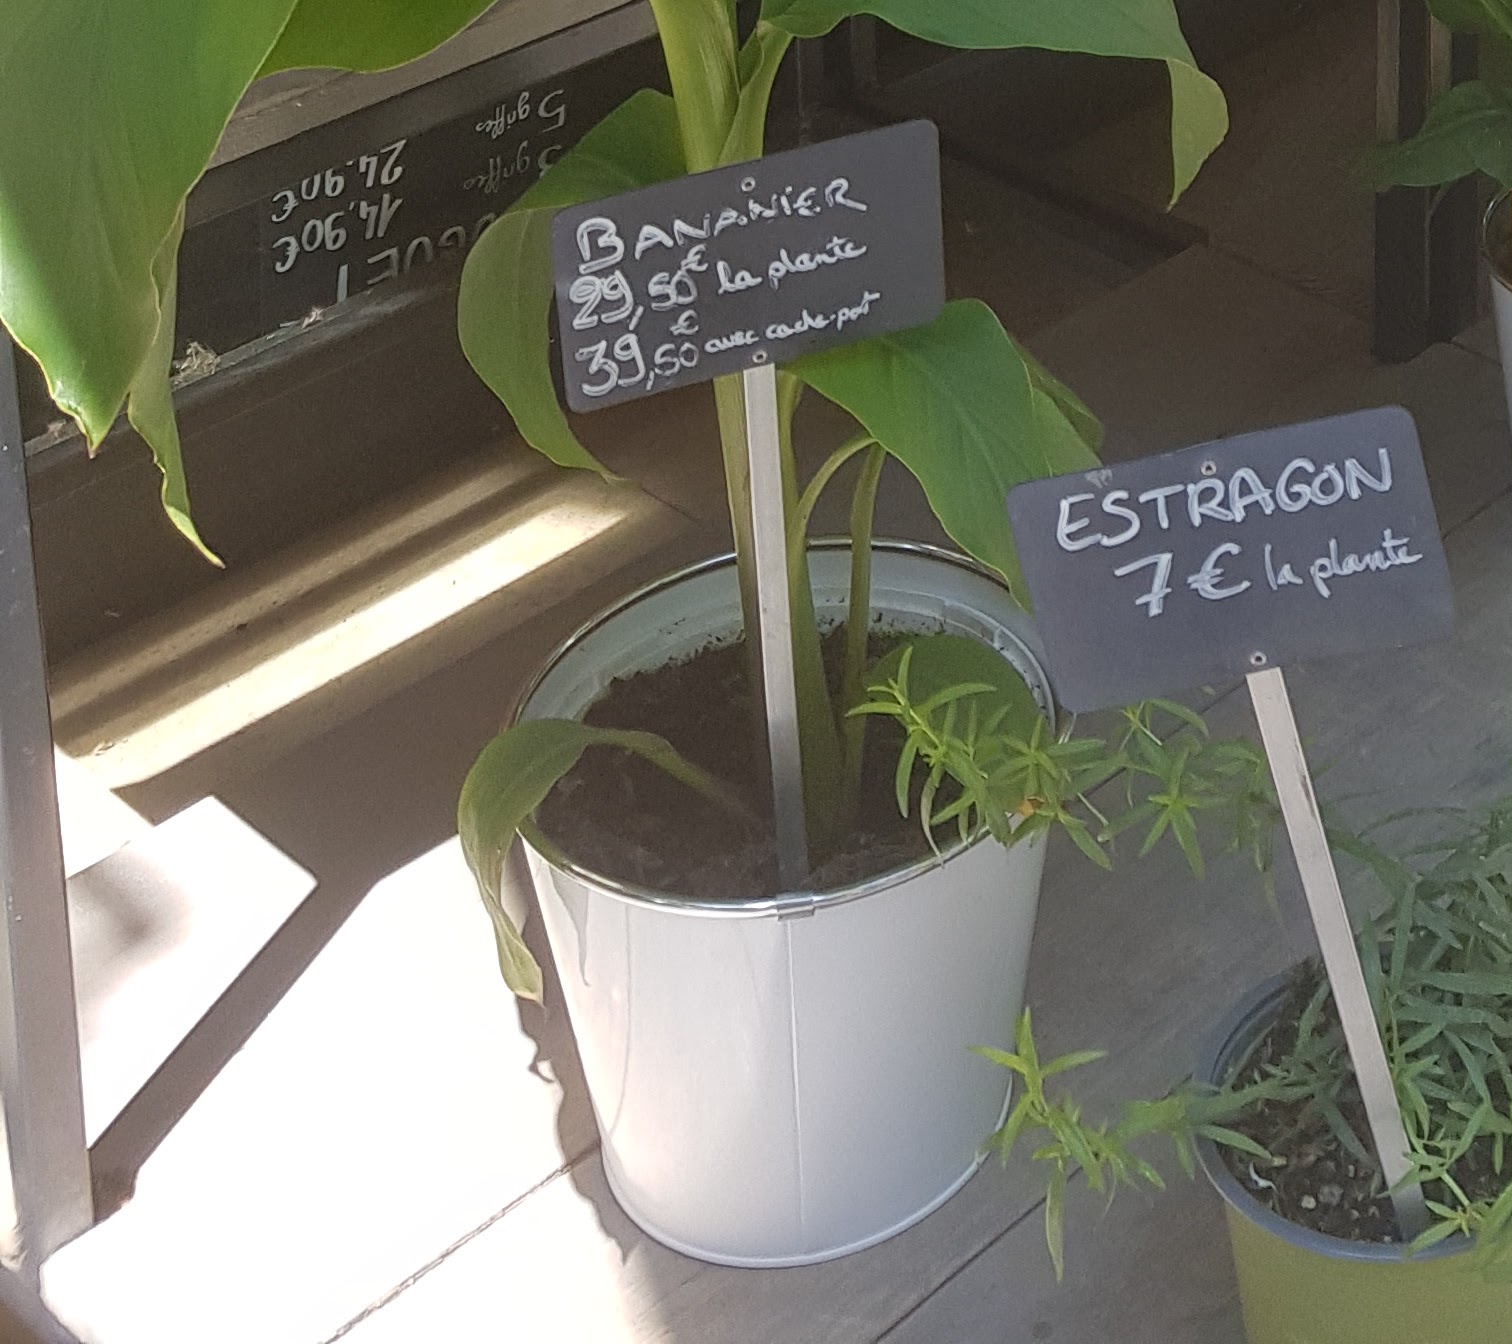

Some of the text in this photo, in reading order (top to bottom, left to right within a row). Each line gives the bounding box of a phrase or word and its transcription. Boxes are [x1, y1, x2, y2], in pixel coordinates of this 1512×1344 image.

[575, 176, 868, 275] BANANIER
[1055, 447, 1393, 553] ESTRAGON
[1263, 542, 1304, 591] la
[1309, 527, 1424, 599] plante
